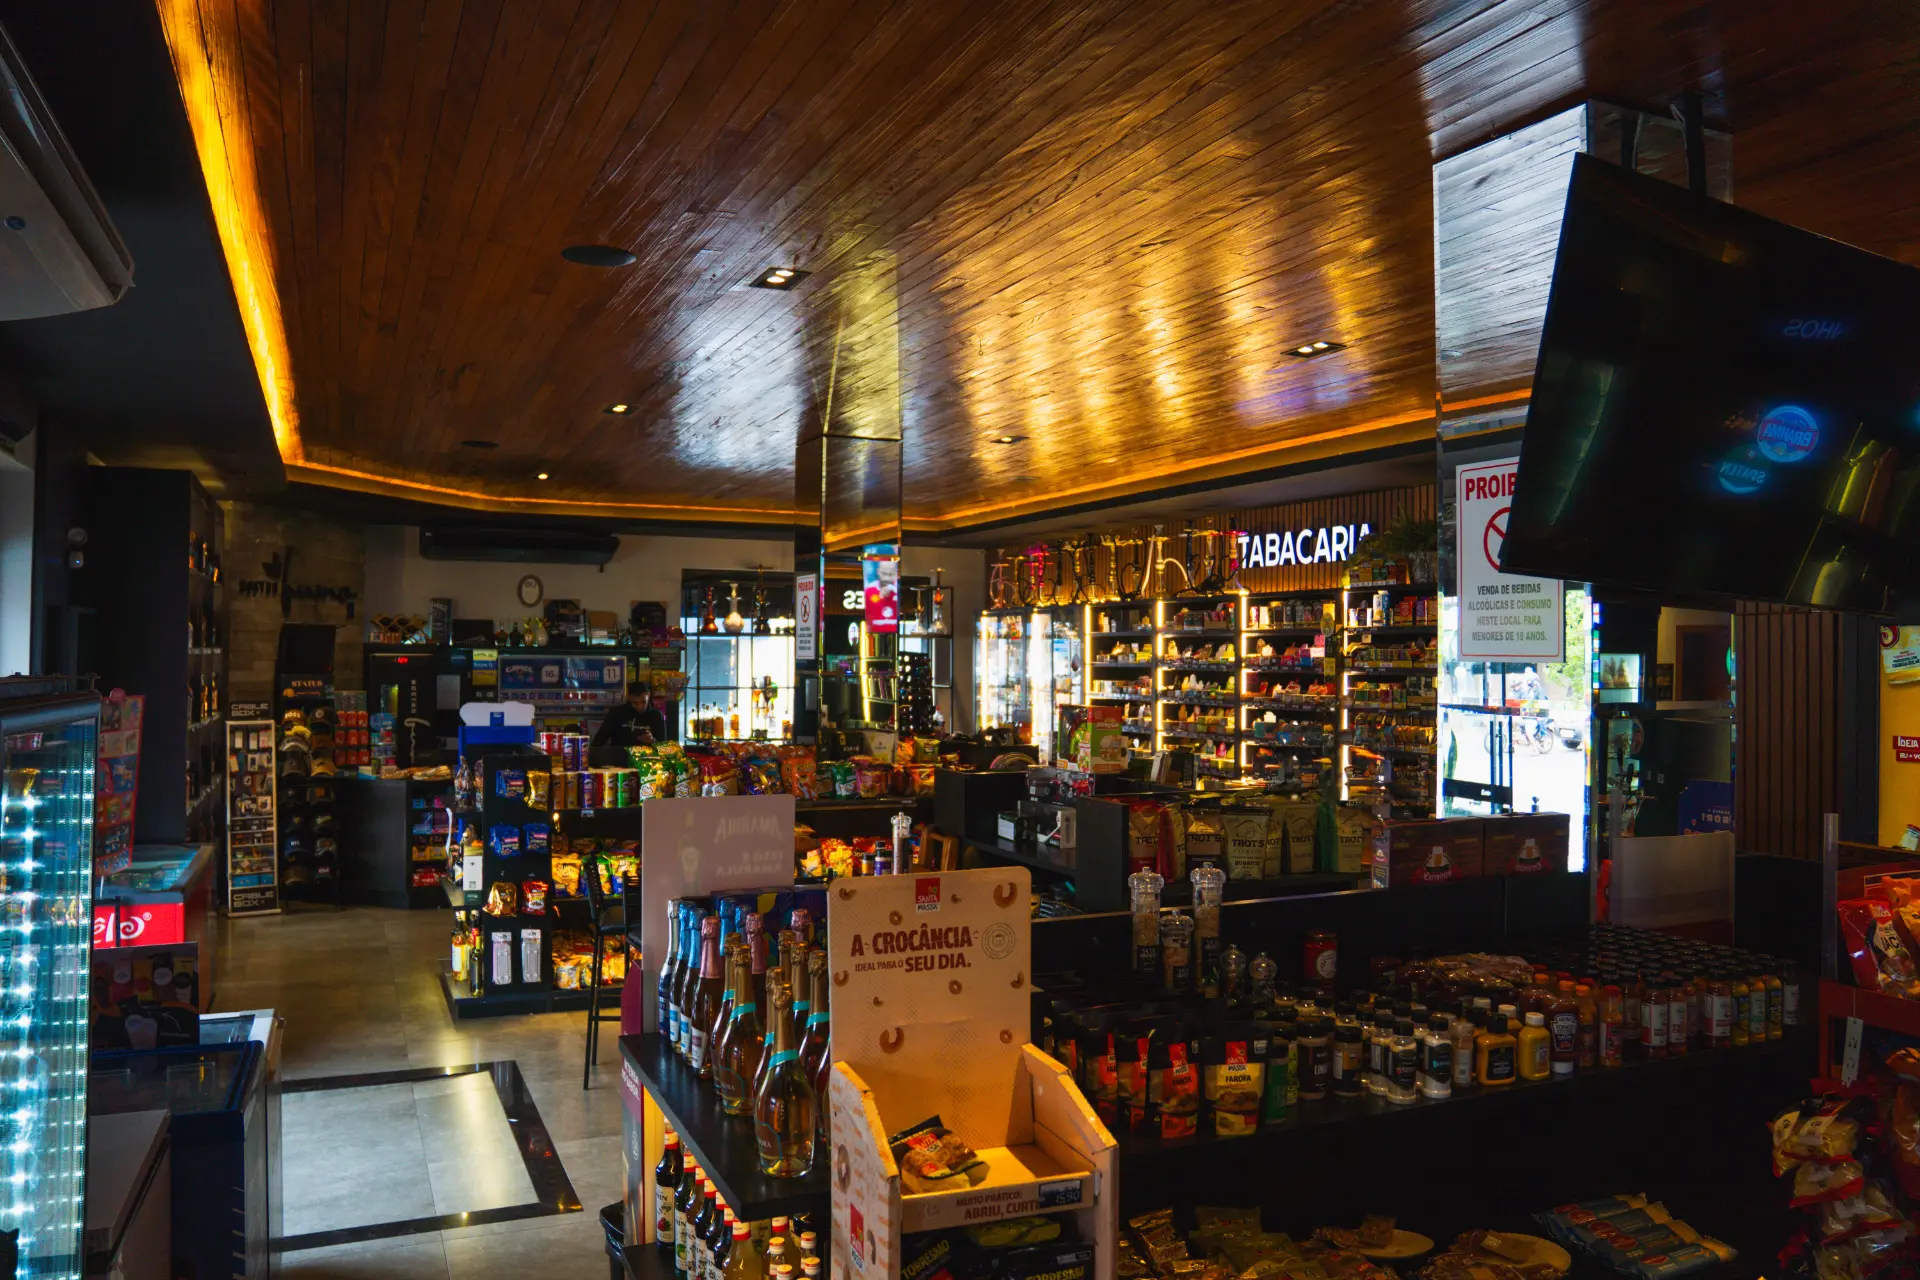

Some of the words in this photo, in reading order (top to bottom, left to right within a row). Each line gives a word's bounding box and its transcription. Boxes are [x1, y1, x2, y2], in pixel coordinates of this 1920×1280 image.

[1465, 472, 1517, 501] PROIB
[1237, 522, 1372, 569] TABACARIA
[1477, 584, 1500, 596] VENDA
[1501, 584, 1510, 595] DE
[1511, 583, 1541, 595] BEBIDAS
[1467, 599, 1509, 611] ALCOÓLICAS
[1510, 600, 1516, 610] E
[1516, 598, 1552, 610] CONSUMO
[1476, 615, 1499, 626] NESTE
[1499, 614, 1522, 625] LOCAL
[1523, 614, 1542, 625] PARA
[1471, 631, 1504, 641] MENORES
[1505, 631, 1515, 641] DE
[230, 702, 269, 711] CABLE
[230, 709, 255, 717] BOX
[1231, 838, 1266, 848] TROT'S
[233, 891, 275, 901] CABLE
[232, 899, 260, 908] BOX
[850, 934, 865, 957] A
[871, 922, 974, 955] CROCÂNCIA
[854, 961, 876, 972] IDEAL
[876, 960, 898, 971] PARA
[898, 959, 904, 968] O
[904, 955, 935, 973] SEU
[937, 952, 972, 970] DIA.
[1225, 1075, 1252, 1083] FAROFA
[956, 1196, 983, 1208] MUITO
[964, 1203, 1005, 1221] ABRIU,
[901, 1238, 951, 1280] TORRESMO
